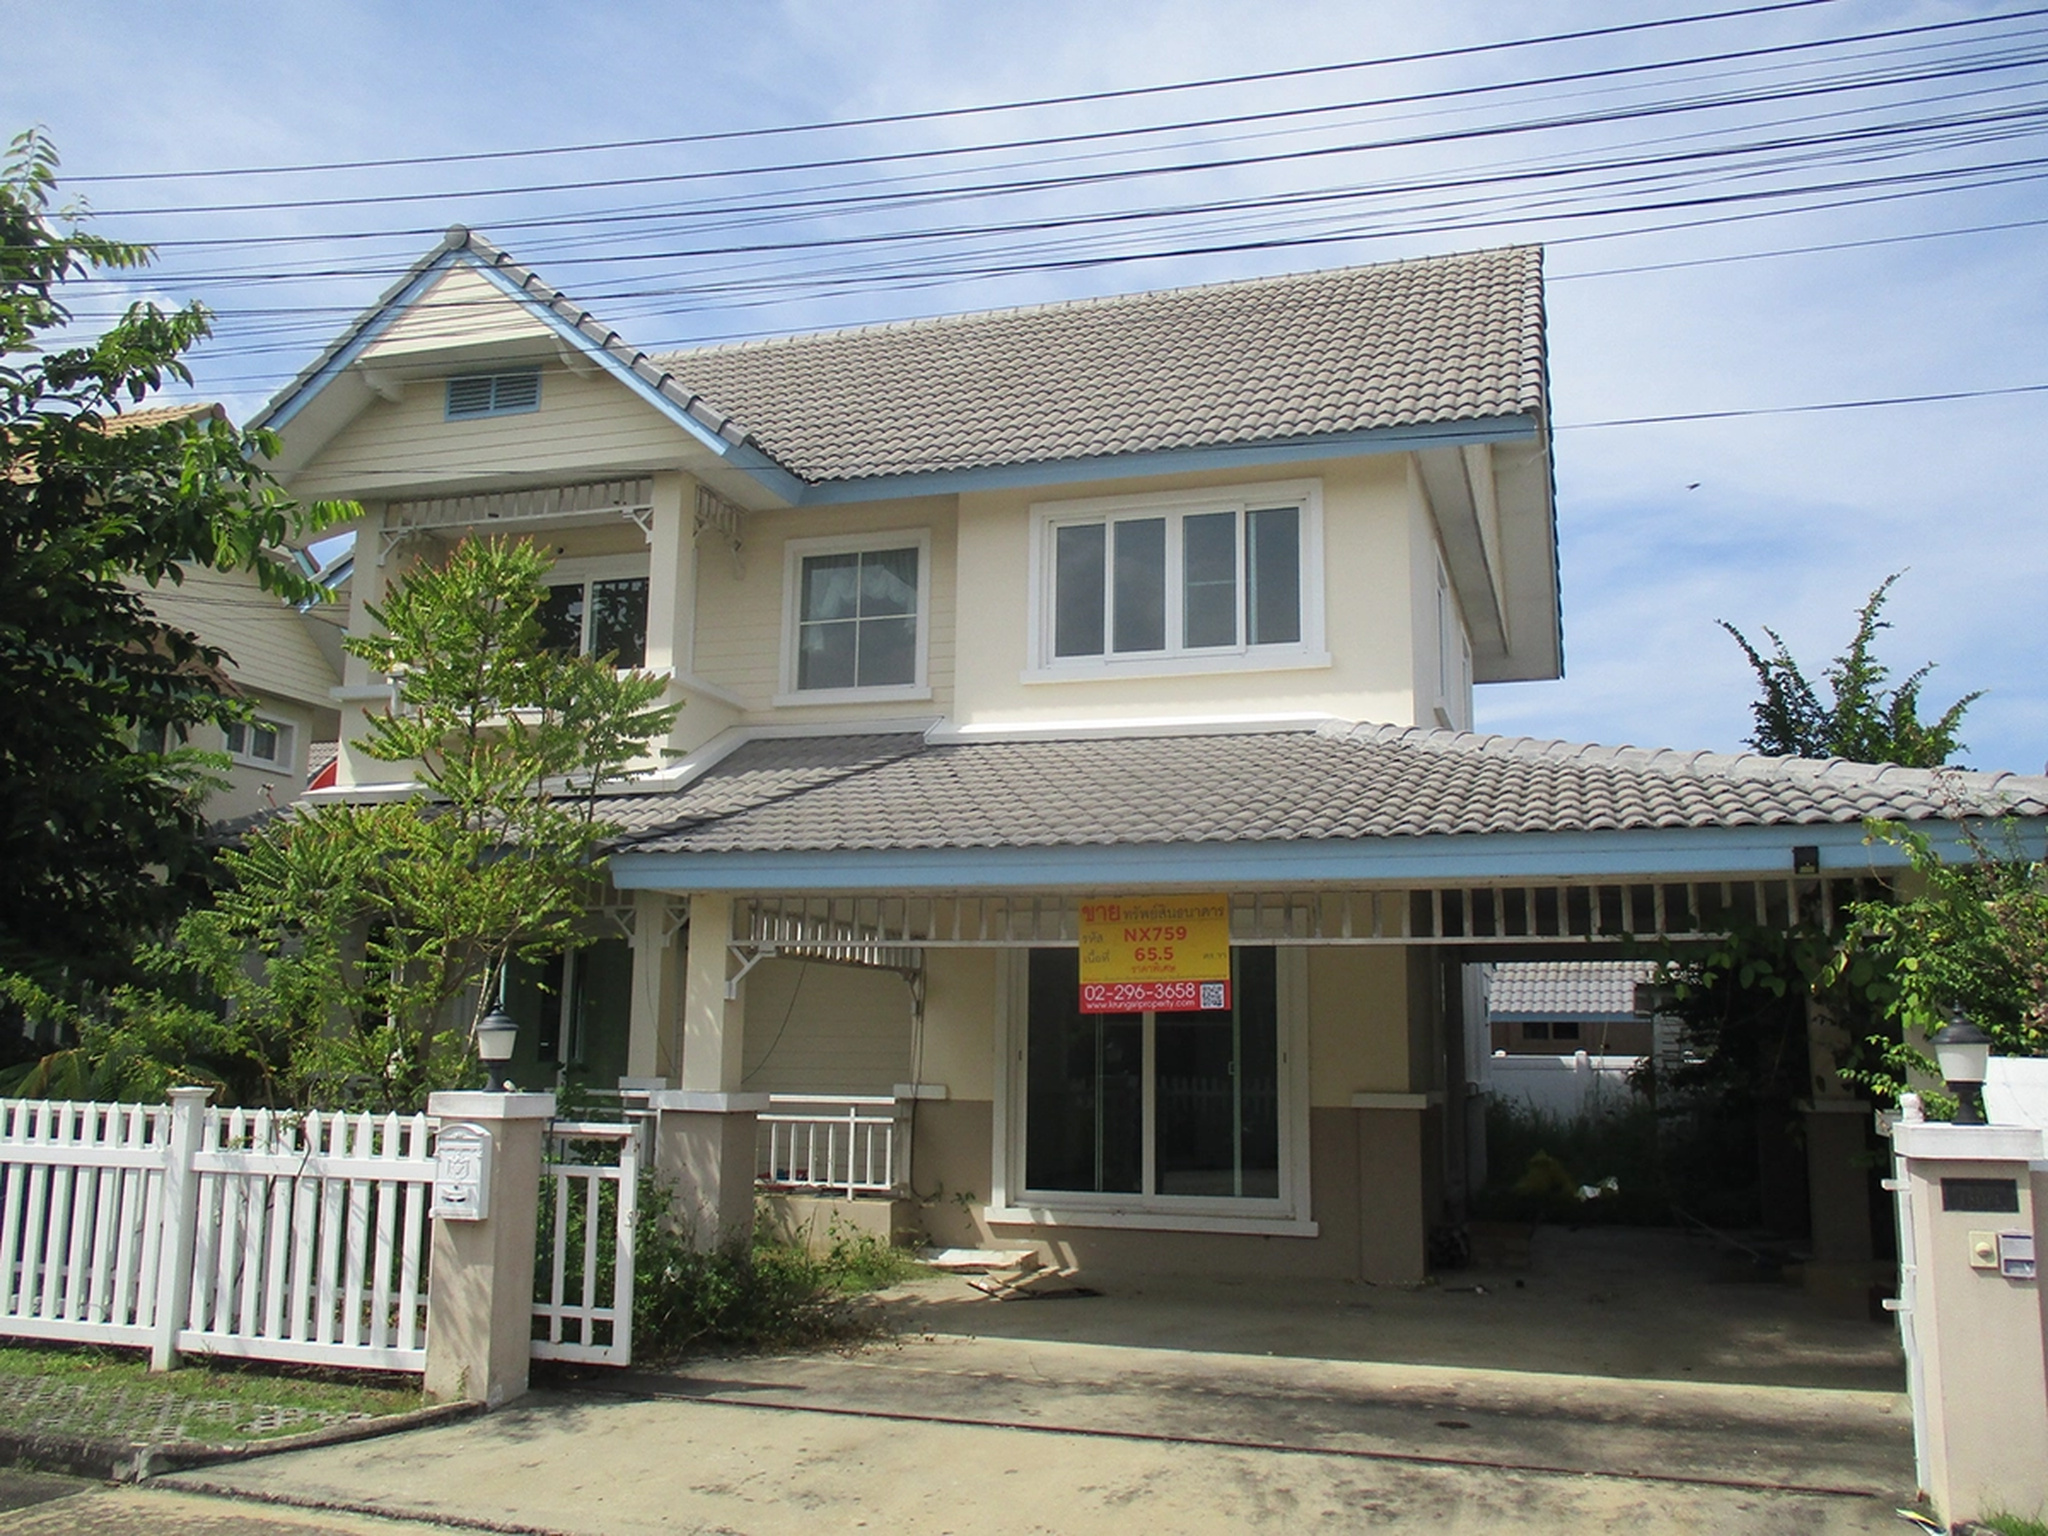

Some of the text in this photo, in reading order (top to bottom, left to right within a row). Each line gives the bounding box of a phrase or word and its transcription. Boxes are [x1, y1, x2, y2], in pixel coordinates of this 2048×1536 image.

[1081, 904, 1121, 923] ขาย
[1124, 926, 1188, 942] NX759
[1134, 947, 1174, 962] 65.5
[1084, 982, 1196, 1001] 02-296-3658
